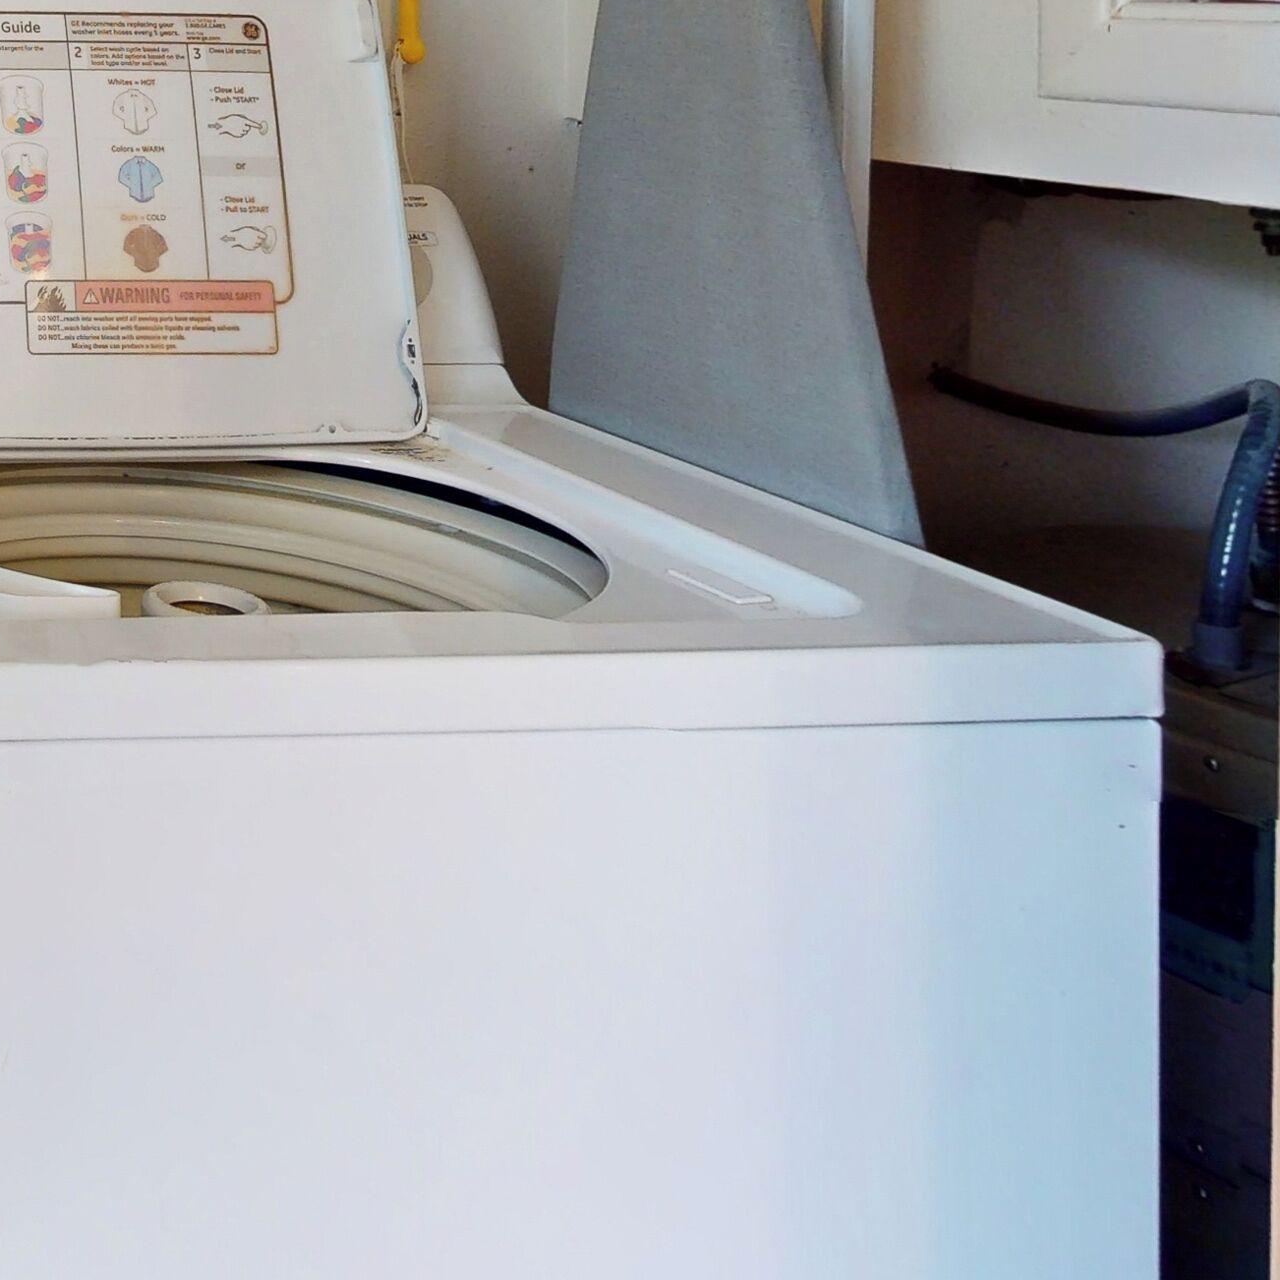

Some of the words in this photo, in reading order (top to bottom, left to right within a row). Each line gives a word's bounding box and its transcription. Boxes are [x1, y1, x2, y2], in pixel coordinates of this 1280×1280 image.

[0, 21, 41, 34] Guide
[74, 47, 82, 58] 2
[193, 47, 201, 59] 3
[107, 78, 133, 86] Whites
[213, 86, 233, 94] Close
[234, 86, 245, 94] Lid
[111, 145, 134, 153] Colors
[224, 195, 243, 203] Close
[225, 205, 239, 213] Pull
[99, 287, 170, 304] WARNING
[180, 292, 196, 301] FOR
[196, 292, 234, 301] PERSONAL
[235, 292, 262, 301] SAFETY
